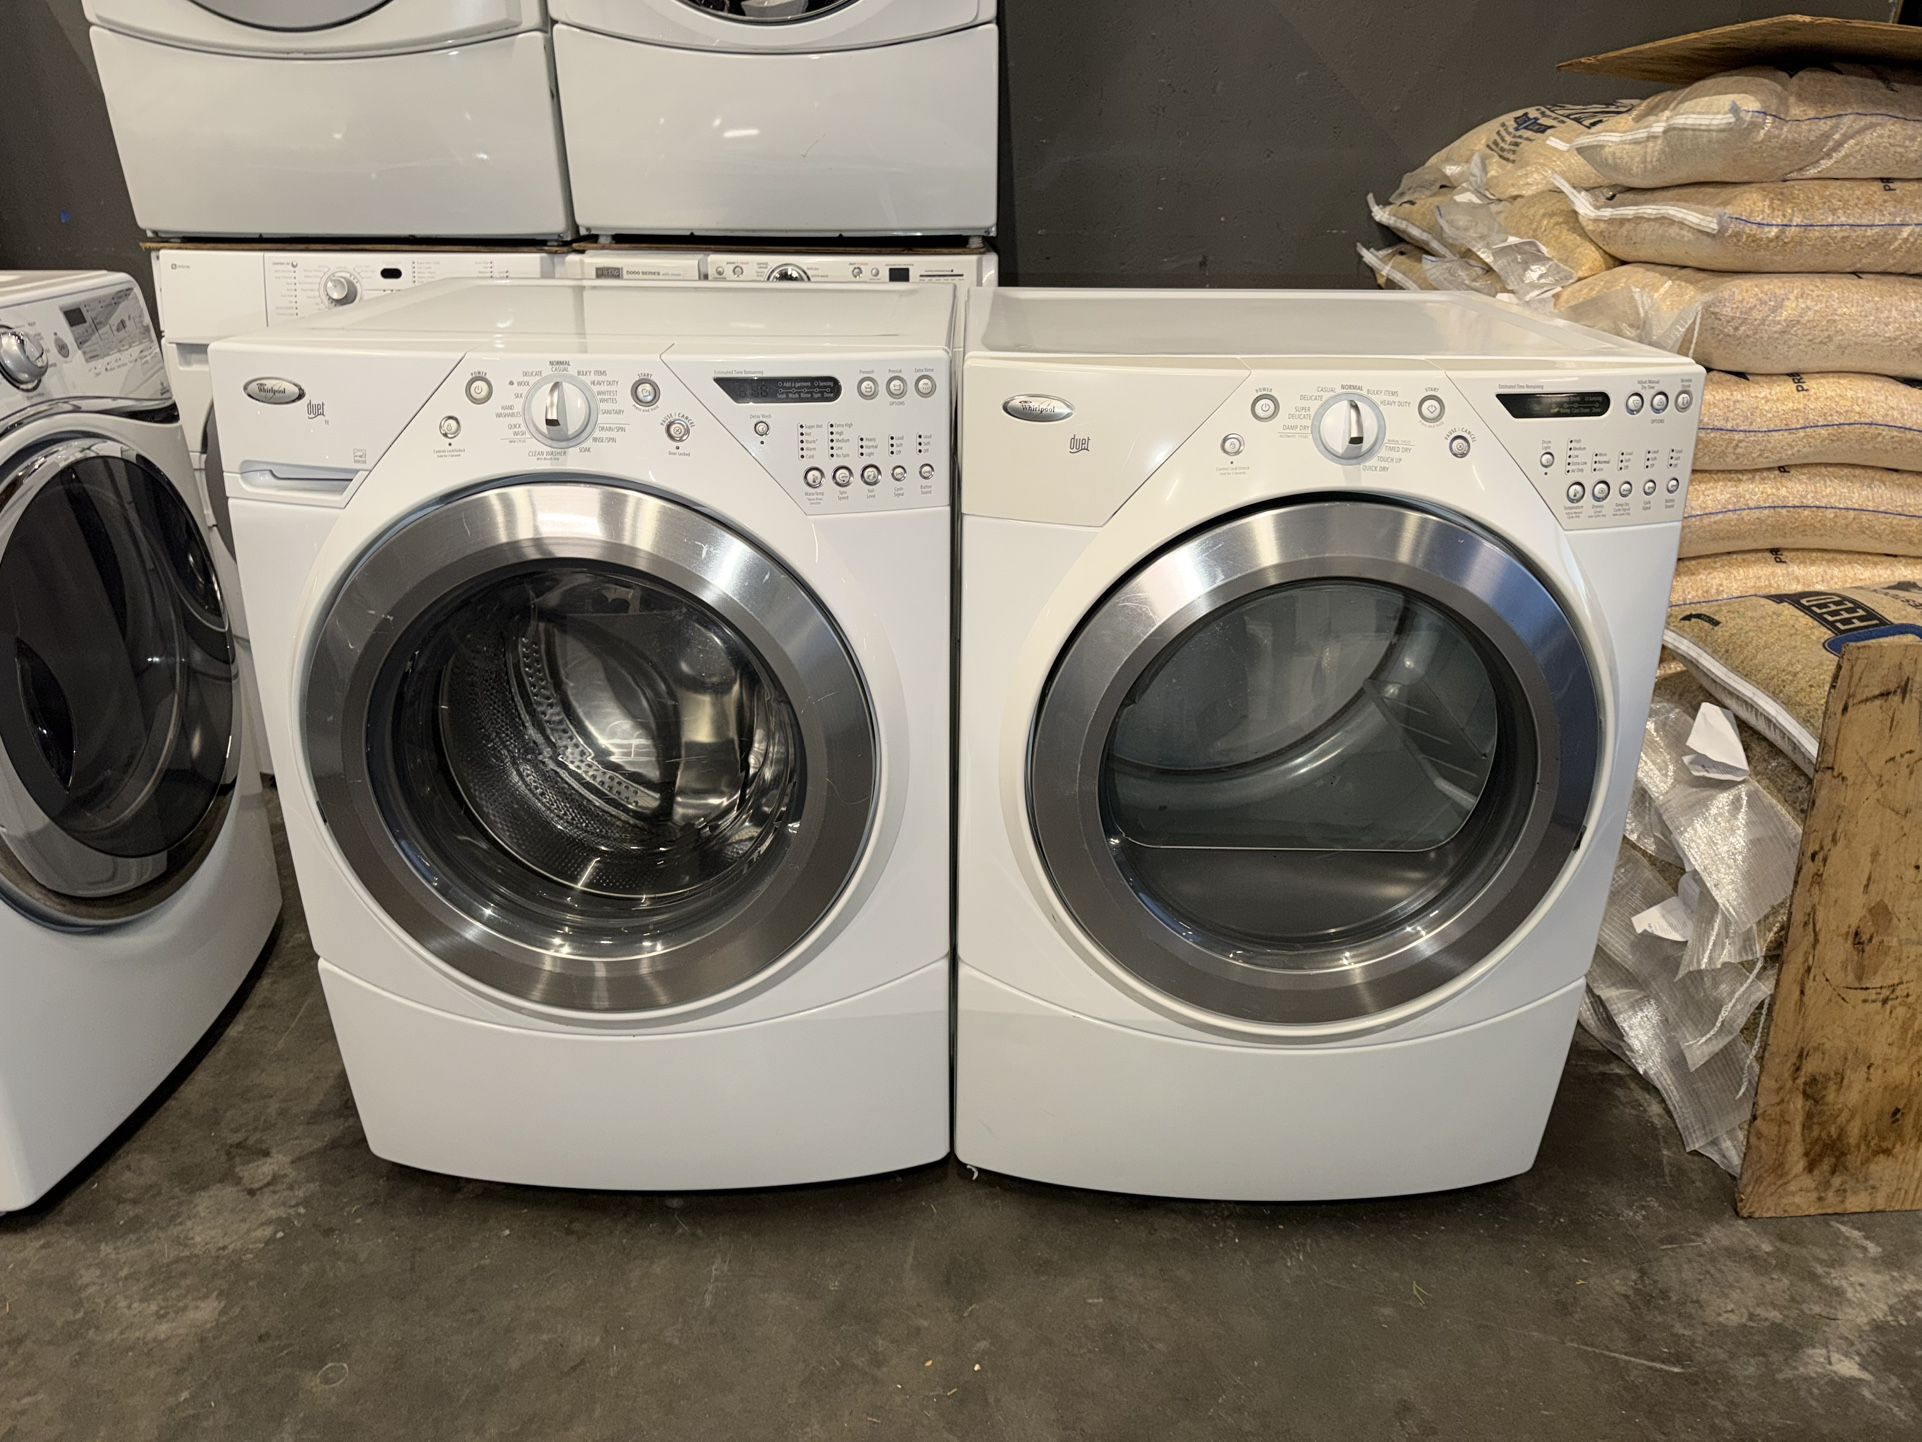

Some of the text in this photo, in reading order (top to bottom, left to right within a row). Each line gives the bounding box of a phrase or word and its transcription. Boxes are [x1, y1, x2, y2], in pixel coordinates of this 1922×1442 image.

[257, 385, 286, 398] Whirlpool
[1300, 394, 1324, 402] DELICATE
[1366, 388, 1382, 396] BULKY
[306, 400, 325, 418] duet
[1021, 404, 1055, 414] Whirlpool
[1397, 400, 1411, 408] DUTY
[660, 413, 674, 426] PAUSE
[678, 412, 696, 428] CANCEL
[1444, 427, 1458, 440] PAUSE
[1461, 427, 1478, 443] CANCEL
[1069, 434, 1091, 453] duet
[1799, 594, 1880, 633] FEED
